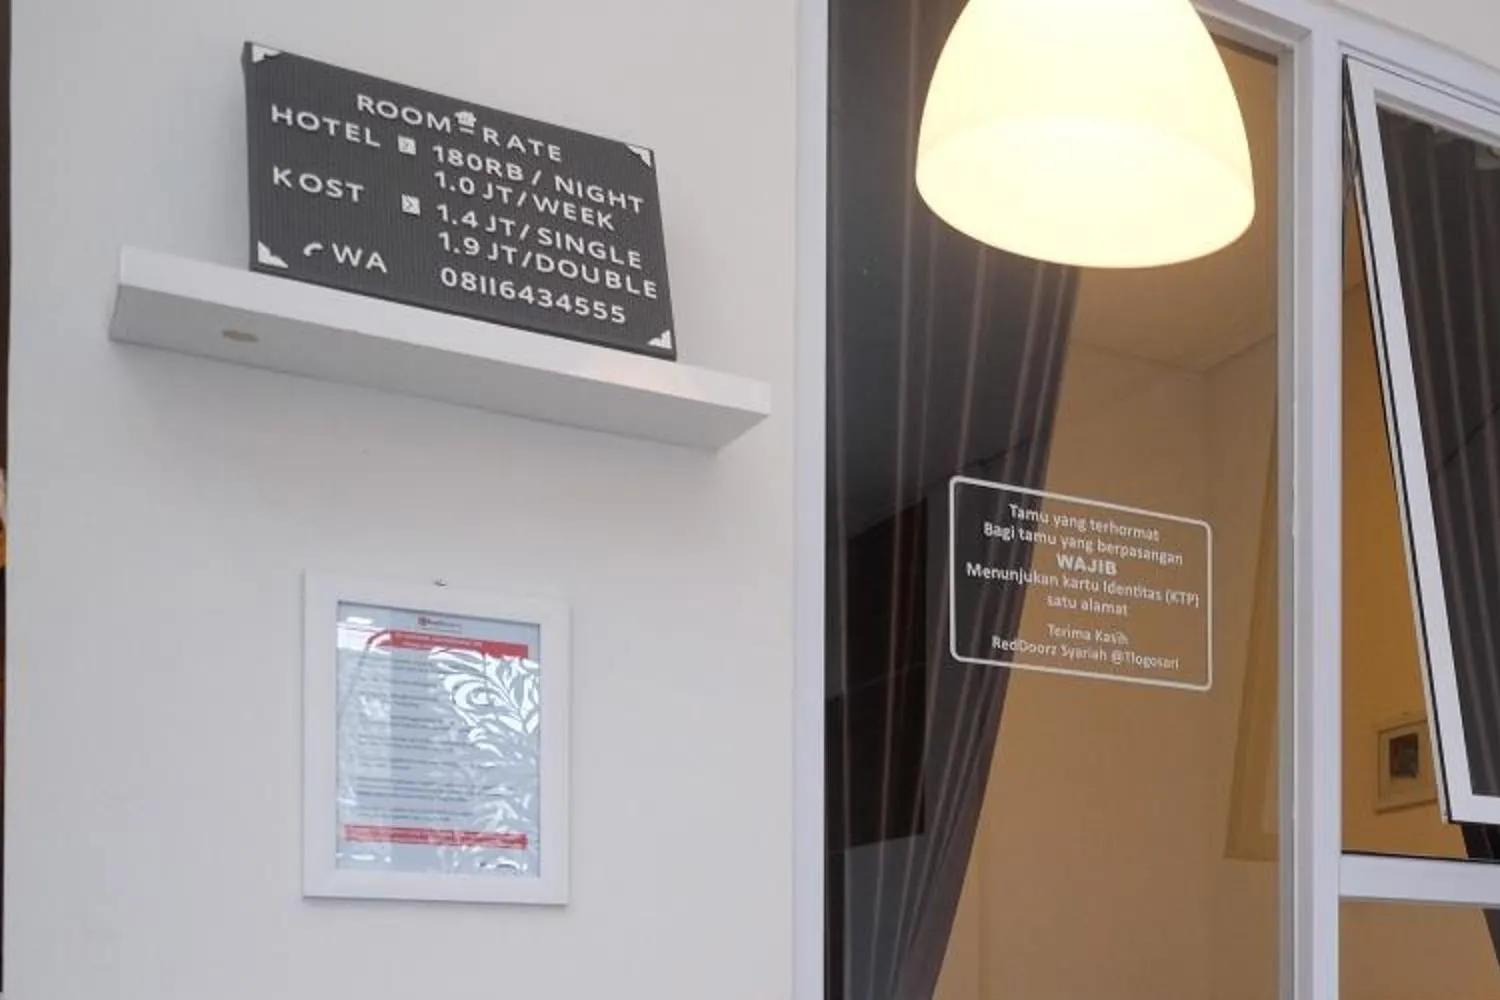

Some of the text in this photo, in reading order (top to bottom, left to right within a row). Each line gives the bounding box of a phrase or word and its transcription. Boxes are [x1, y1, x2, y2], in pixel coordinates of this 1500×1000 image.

[357, 93, 562, 163] ROOM RATE
[271, 104, 382, 148] HOTEL
[432, 144, 524, 183] 180RB
[555, 175, 645, 215] NIGHT
[272, 166, 365, 203] KOST
[437, 203, 479, 230] 1.4
[434, 170, 475, 196] 1.0
[438, 230, 481, 257] 1.9
[333, 242, 627, 325] WA 08116434555
[1008, 503, 1160, 542] Tamu yang terhormat
[983, 521, 1183, 566] Bagi tamu yang berpasangan
[966, 562, 1059, 586] Menunjukan
[1063, 575, 1100, 592] kartu
[1056, 552, 1118, 576] WAJIB
[1081, 597, 1129, 617] alamat
[992, 636, 1058, 656] RedDoorz
